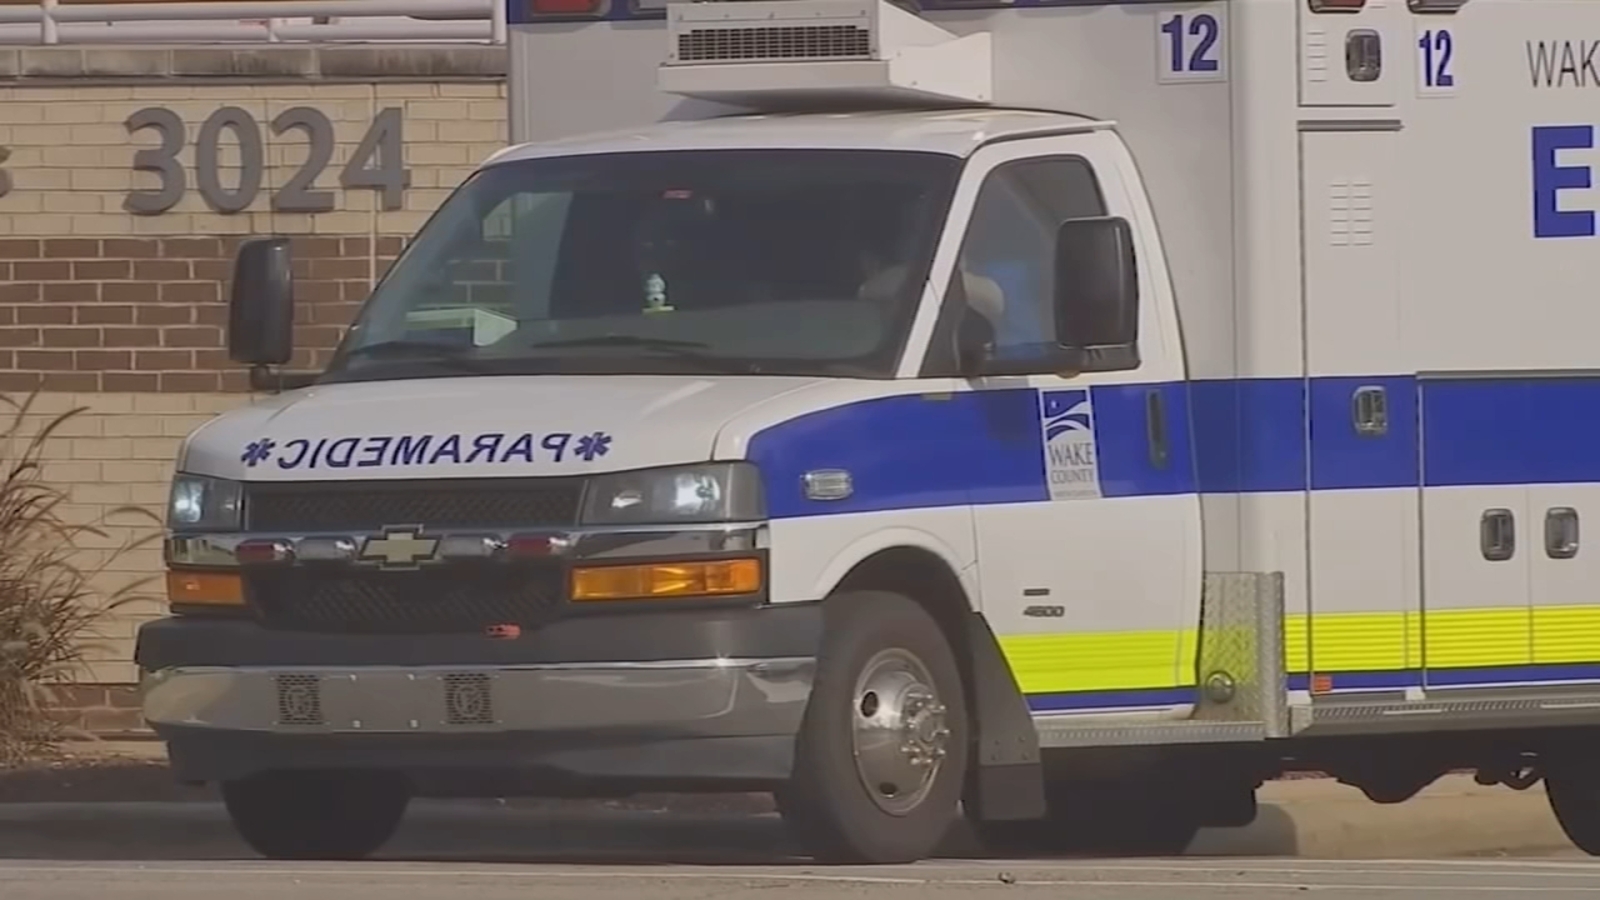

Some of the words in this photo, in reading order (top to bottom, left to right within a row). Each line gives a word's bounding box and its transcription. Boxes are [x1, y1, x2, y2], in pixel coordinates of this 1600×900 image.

[1161, 13, 1219, 73] 12
[1418, 29, 1454, 88] 12
[1526, 39, 1600, 88] WAK
[122, 105, 411, 216] 3024
[1531, 125, 1595, 238] E
[1047, 442, 1094, 466] WAKE
[1051, 468, 1094, 485] COUNTY
